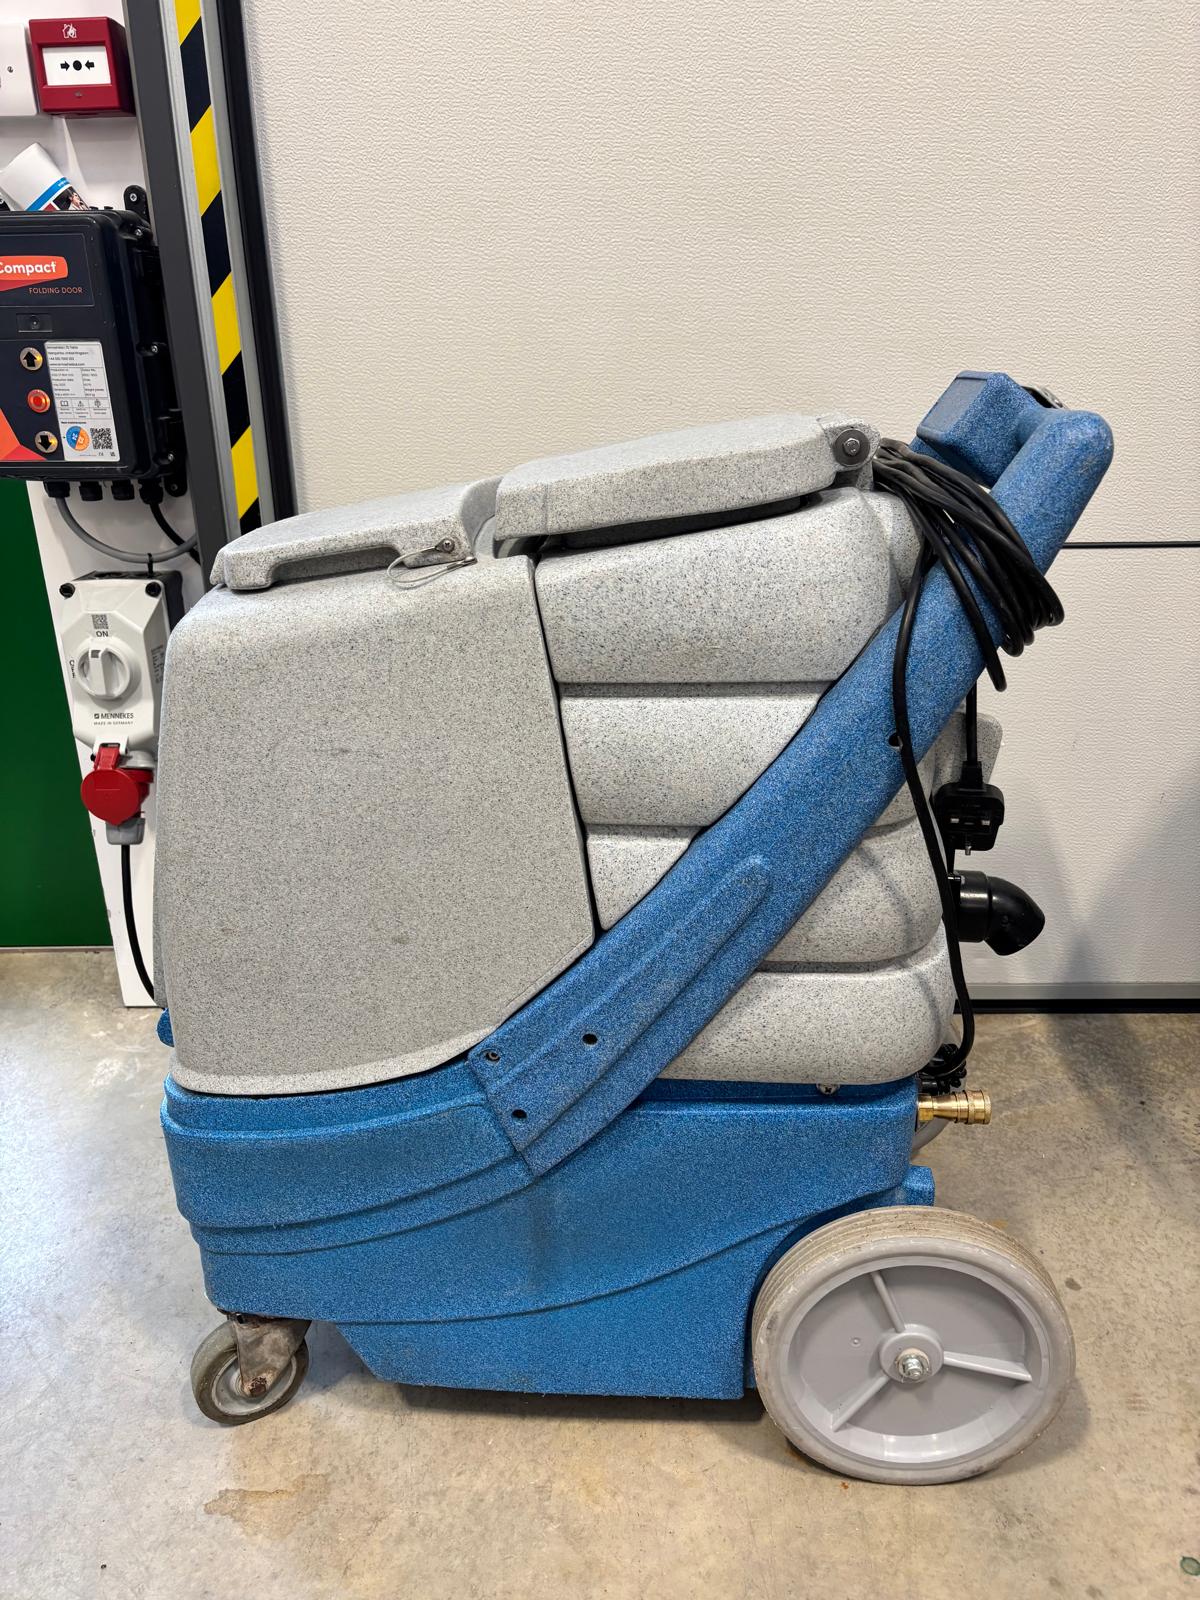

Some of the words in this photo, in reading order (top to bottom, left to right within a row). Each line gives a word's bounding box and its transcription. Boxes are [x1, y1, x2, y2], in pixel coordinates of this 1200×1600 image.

[28, 287, 60, 295] FOLDING
[61, 286, 83, 294] DOOR
[95, 630, 109, 638] ON
